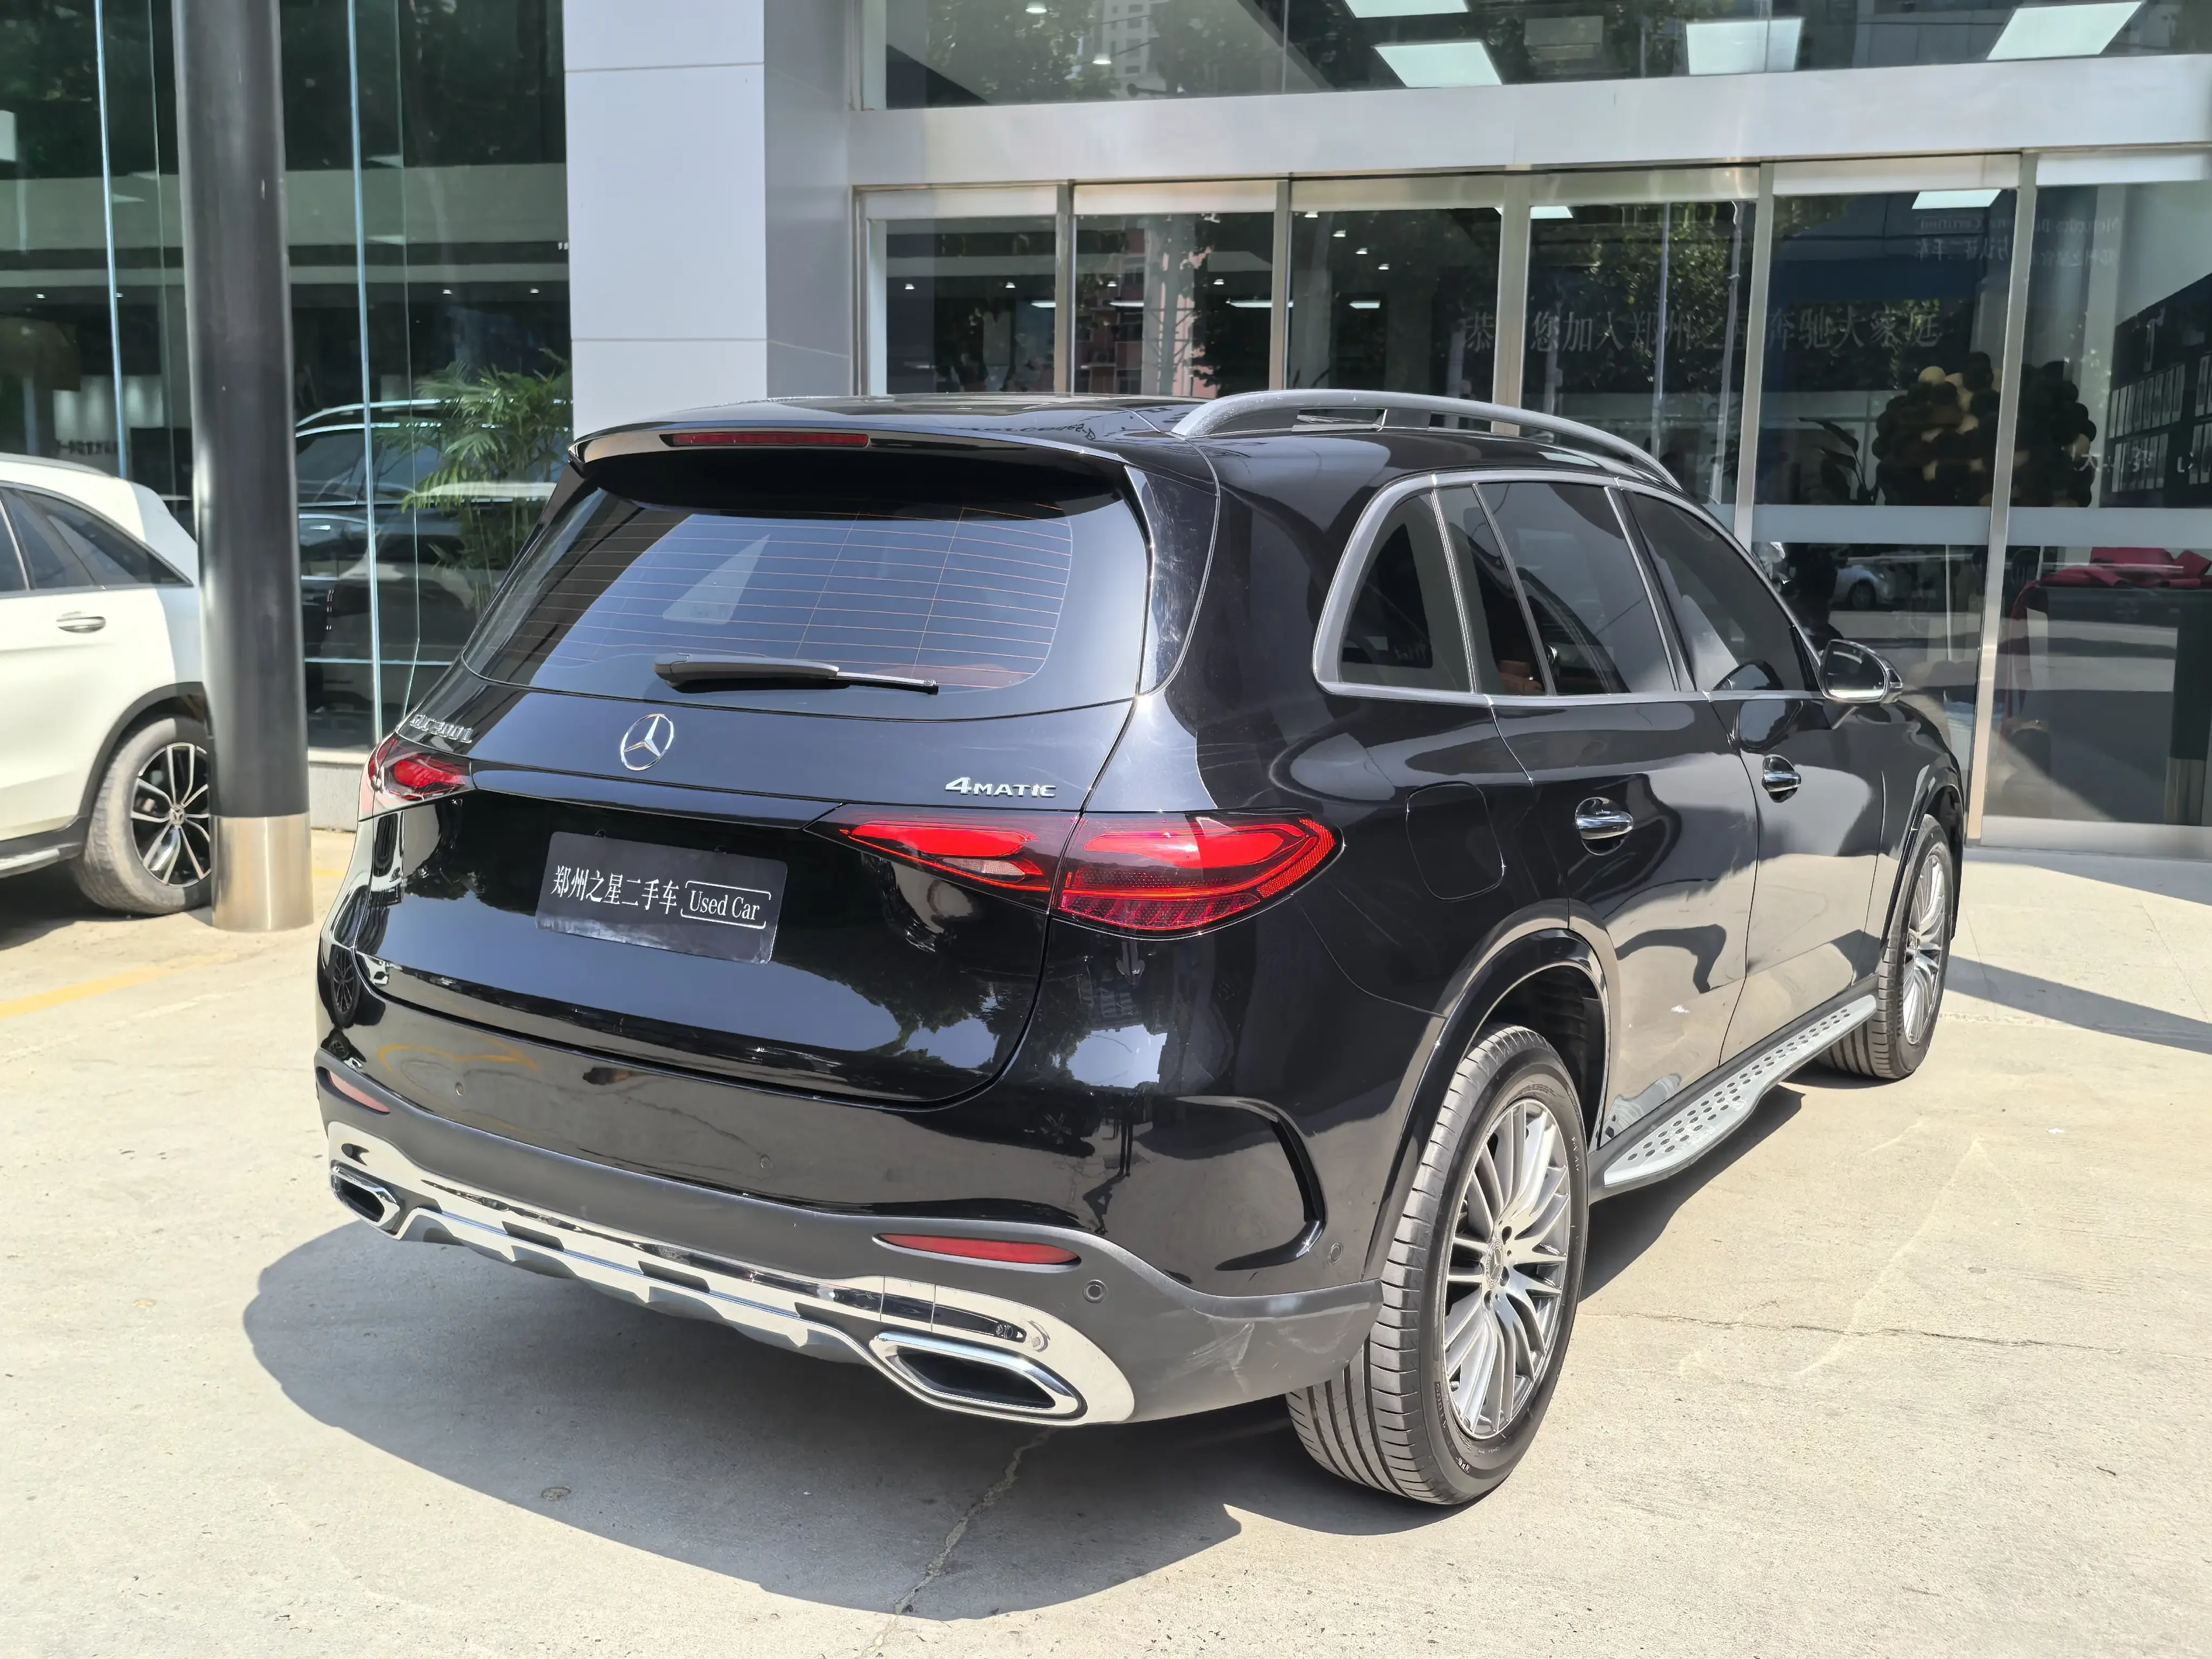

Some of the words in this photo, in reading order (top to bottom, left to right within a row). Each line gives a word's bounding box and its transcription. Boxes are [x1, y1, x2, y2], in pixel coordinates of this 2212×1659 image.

[945, 776, 1057, 798] 4MATIC
[551, 865, 679, 914] 郑州之星二手车
[690, 890, 728, 916] Used
[732, 896, 760, 920] Car
